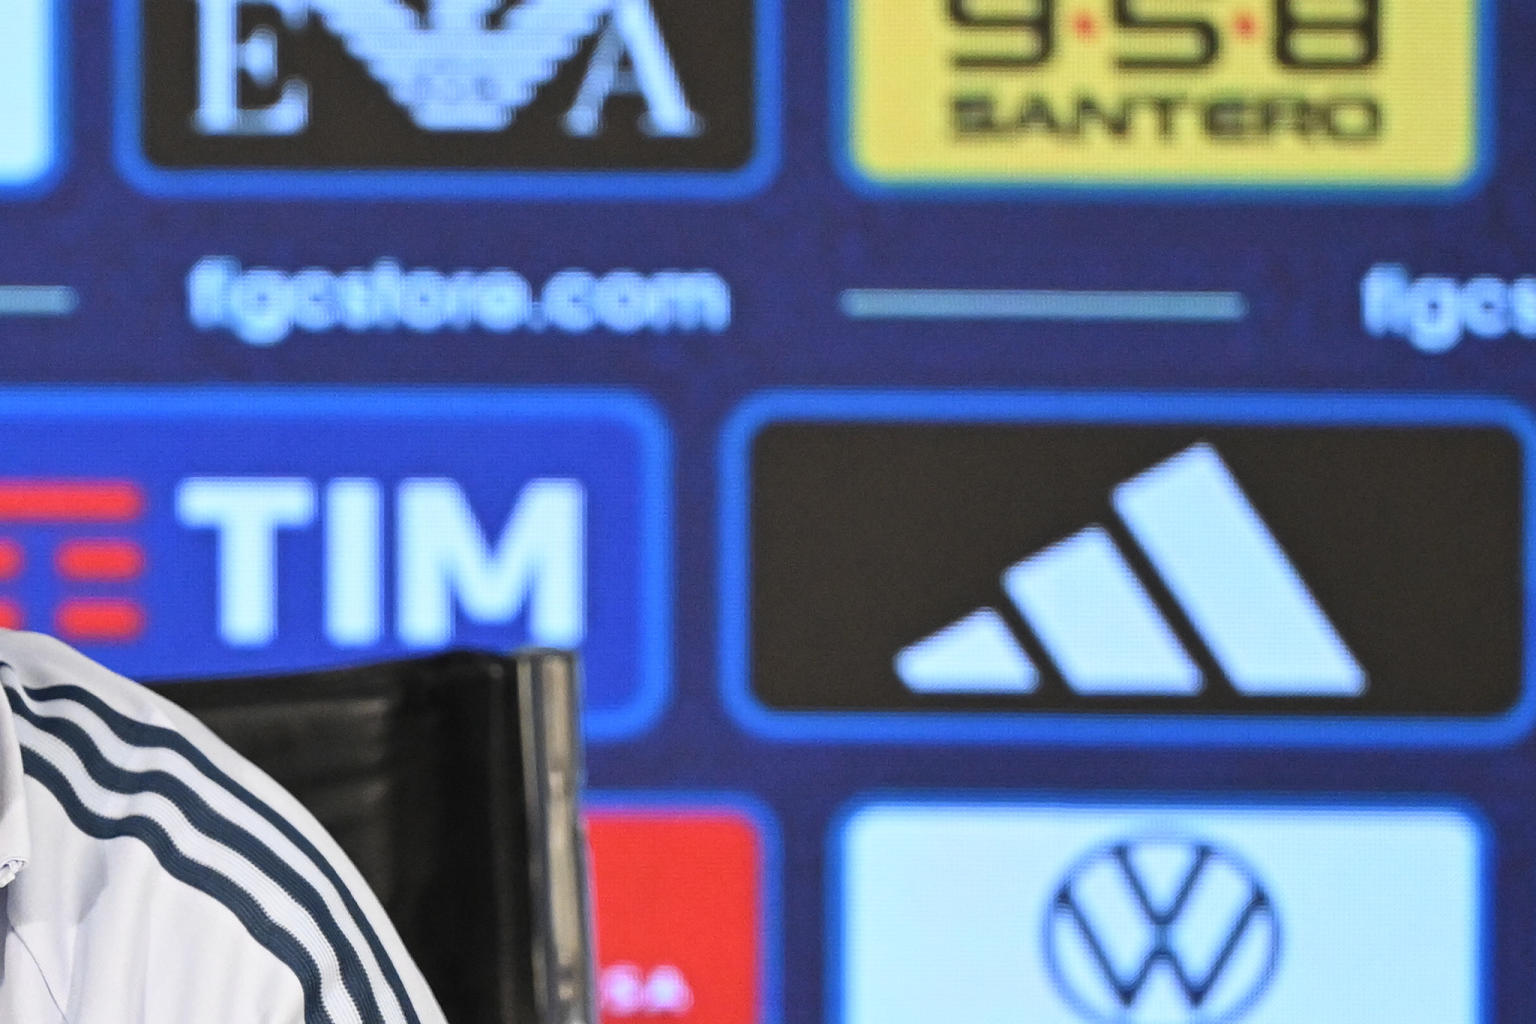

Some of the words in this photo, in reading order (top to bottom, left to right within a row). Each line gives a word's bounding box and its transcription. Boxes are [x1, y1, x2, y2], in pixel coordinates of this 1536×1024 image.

[949, 93, 1380, 141] SANTERO
[186, 256, 732, 345] figcstore.com
[175, 475, 586, 648] TIM
